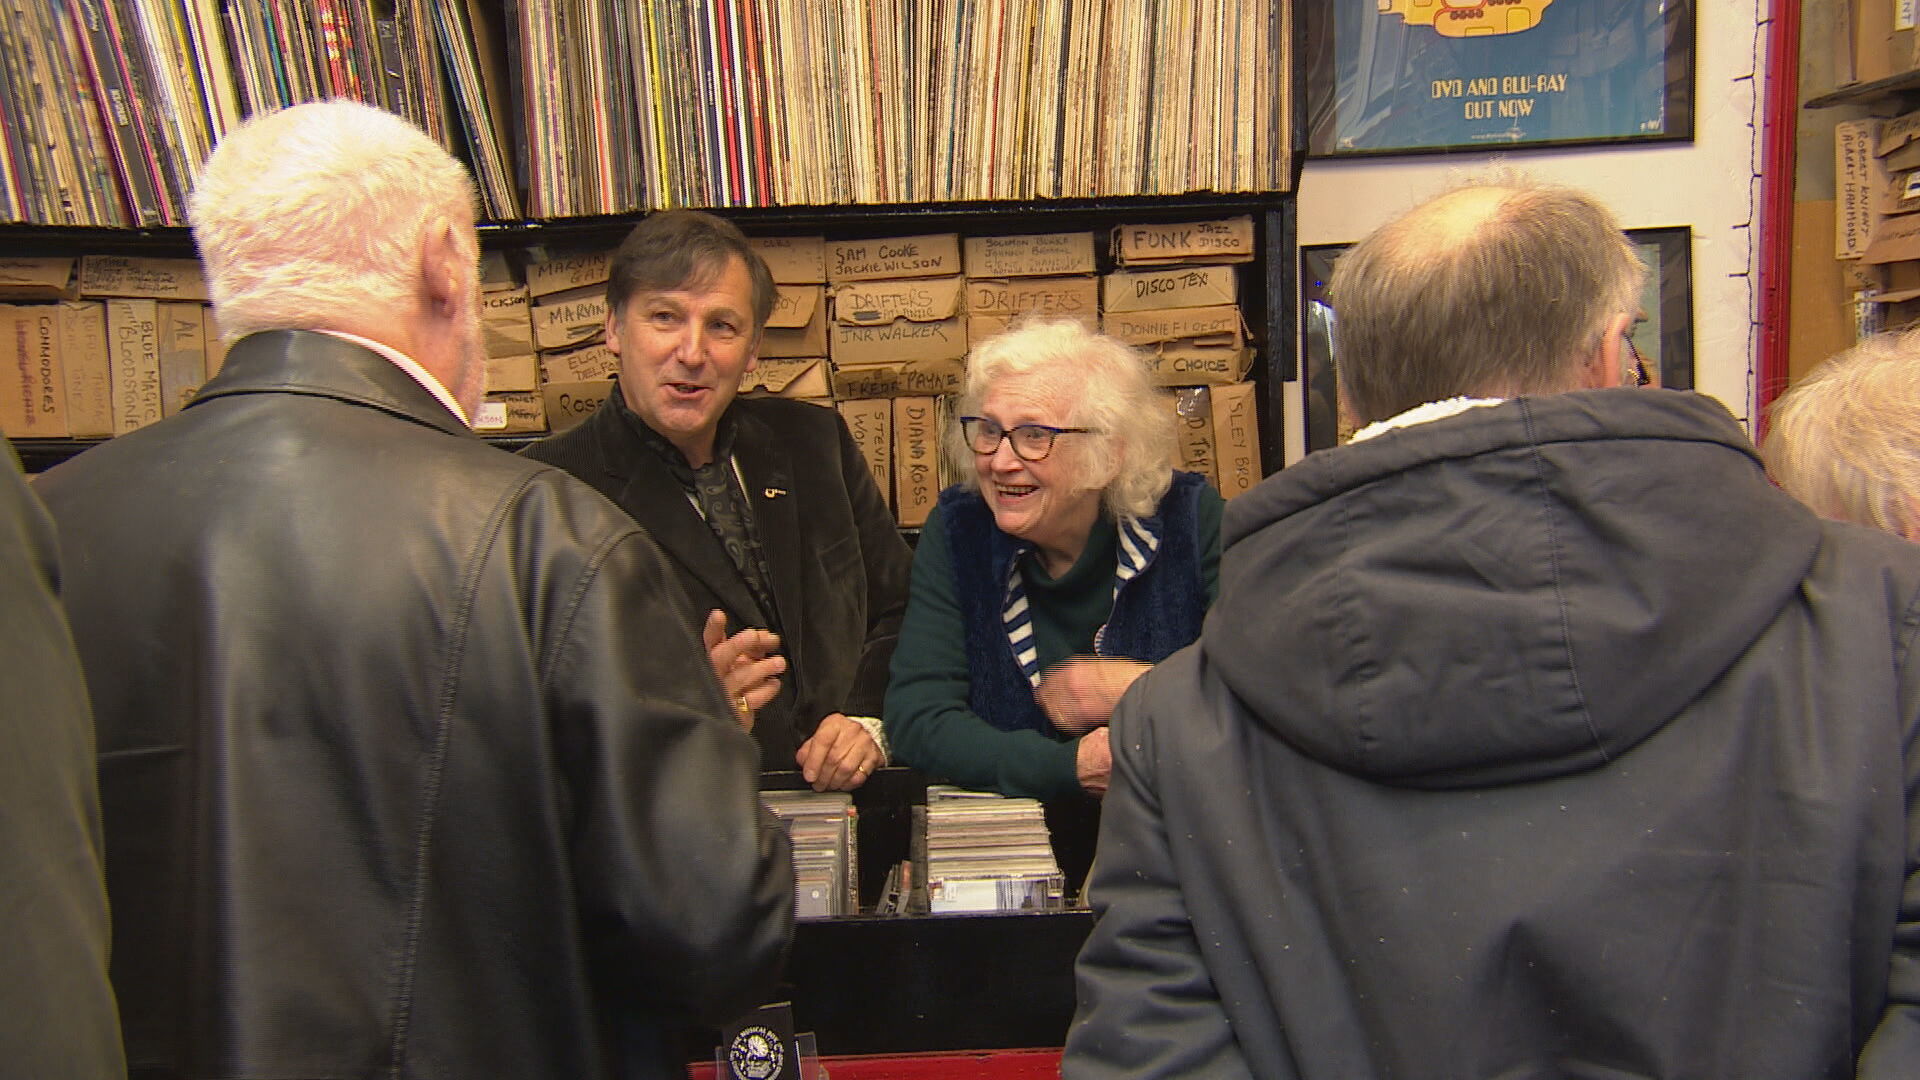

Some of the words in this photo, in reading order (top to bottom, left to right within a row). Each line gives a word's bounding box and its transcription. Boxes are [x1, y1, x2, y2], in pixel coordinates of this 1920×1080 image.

[1431, 79, 1463, 99] DVD
[1466, 77, 1498, 97] AND
[1502, 73, 1567, 95] BLU-RAY
[1464, 100, 1494, 120] OUT
[1498, 98, 1535, 118] NOW
[1134, 230, 1192, 249] FUNK
[1197, 223, 1232, 234] JAZZ
[1199, 238, 1240, 248] DISCO
[836, 247, 866, 264] SAM
[879, 242, 919, 259] COOKE
[538, 255, 606, 278] MARVIN
[834, 262, 881, 276] JACKIE
[883, 256, 942, 272] WILSON
[1136, 279, 1175, 298] DISCO
[1178, 271, 1208, 289] TEX
[851, 287, 933, 311] DRIFTERS
[975, 289, 1082, 312] DRIFTERS
[550, 303, 606, 325] MARVIN
[840, 330, 874, 345] JNR
[877, 324, 948, 343] WALKER
[1120, 322, 1168, 337] DONNIE
[141, 321, 153, 364] BLUE
[39, 315, 55, 415] COMMODORES
[118, 326, 140, 428] BLOODSTONE
[1173, 357, 1230, 372] CHOICE
[141, 370, 157, 421] MAGIC
[906, 406, 927, 461] DIANA
[1229, 396, 1247, 448] ISLEY
[873, 411, 886, 479] STEVIE
[909, 464, 929, 506] ROSS
